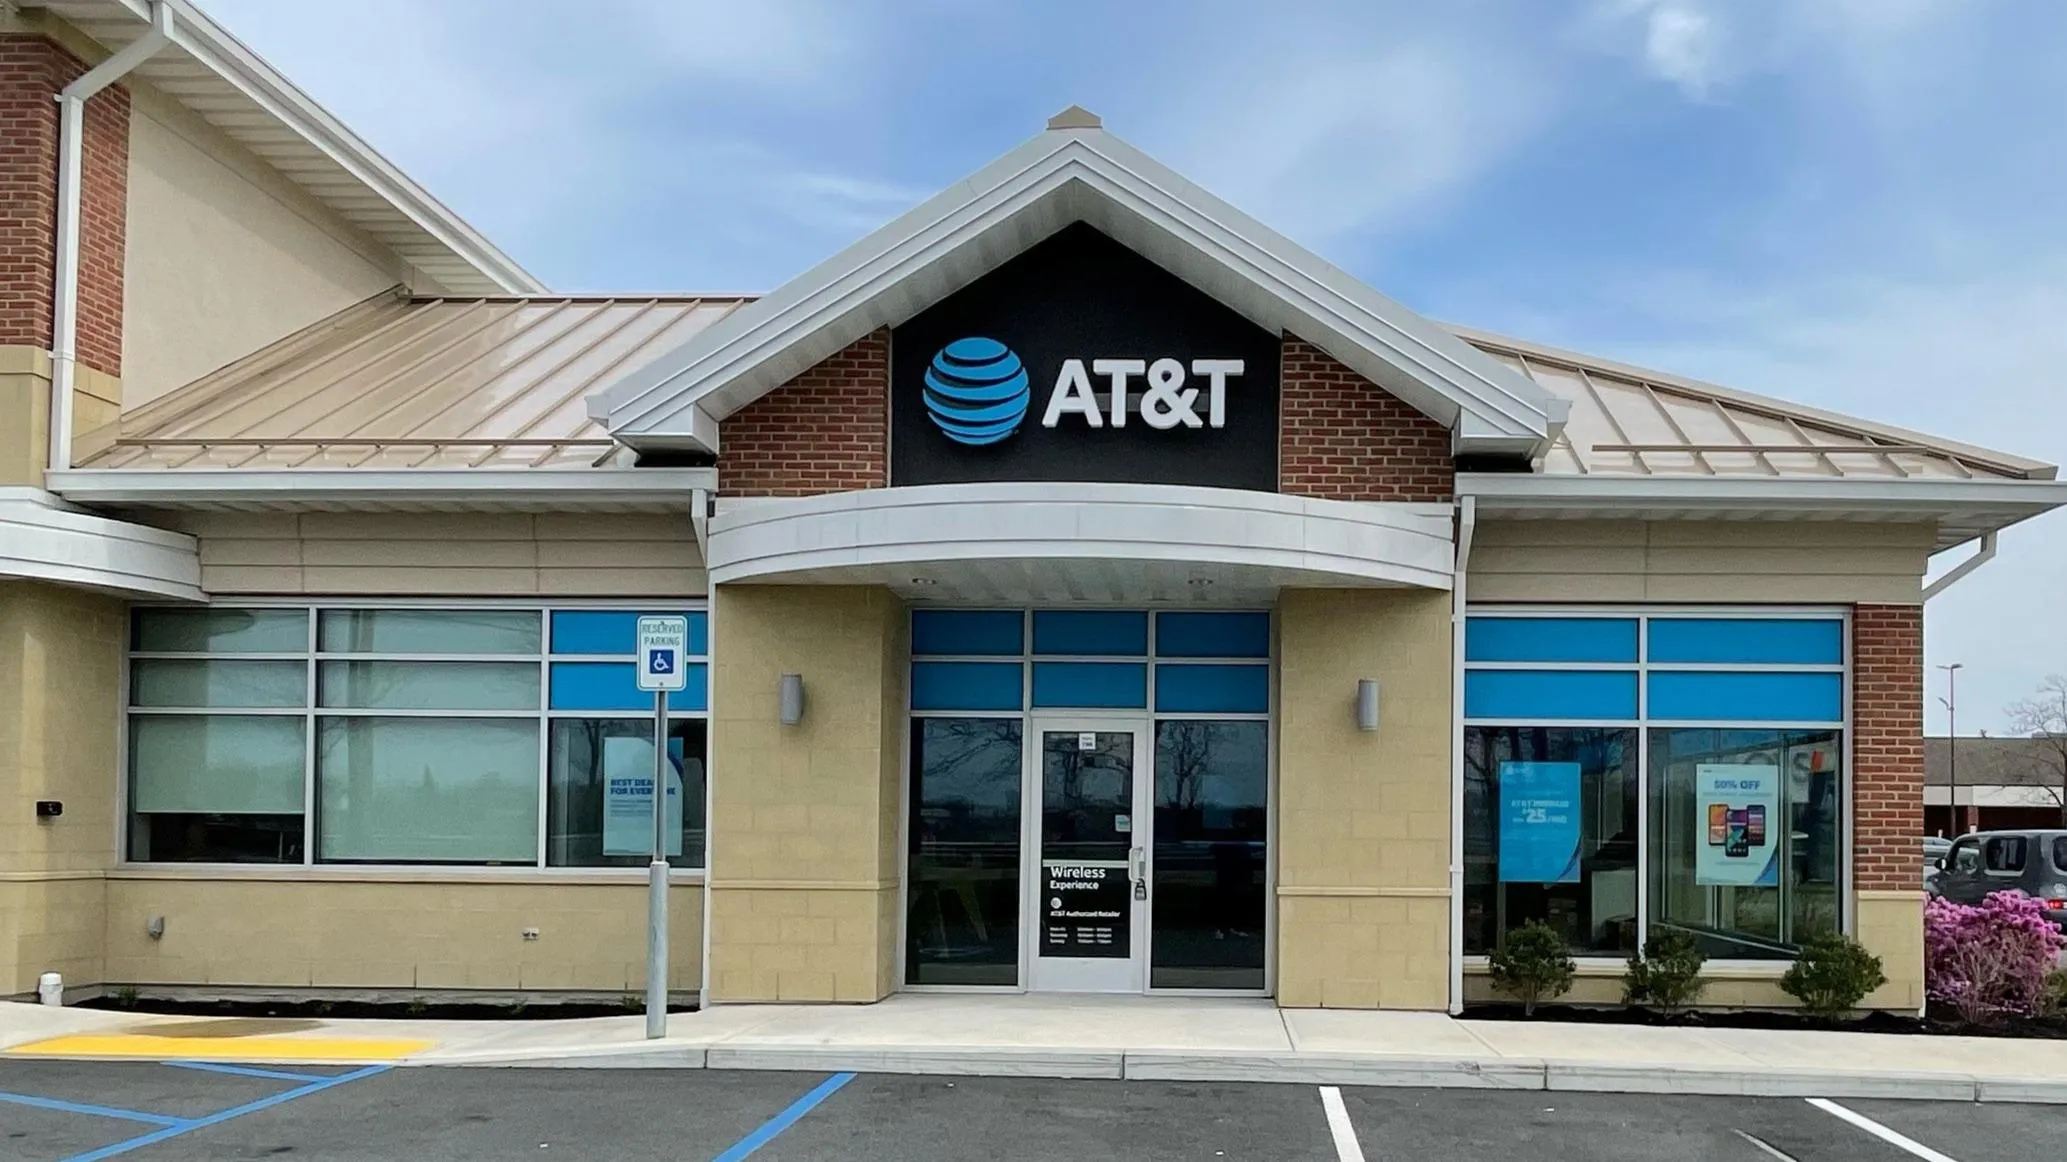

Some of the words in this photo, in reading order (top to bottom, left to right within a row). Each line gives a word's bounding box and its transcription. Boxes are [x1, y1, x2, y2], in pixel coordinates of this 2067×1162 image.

[1042, 358, 1245, 429] AT&T
[641, 624, 683, 633] RESERVED
[644, 636, 680, 646] PARKING
[610, 778, 632, 787] BEST
[634, 778, 654, 787] DEA
[1740, 780, 1760, 789] OFF
[610, 787, 628, 795] FOR
[630, 787, 676, 795] EVERNE
[1050, 866, 1106, 878] Wireless
[1050, 880, 1100, 891] Experience
